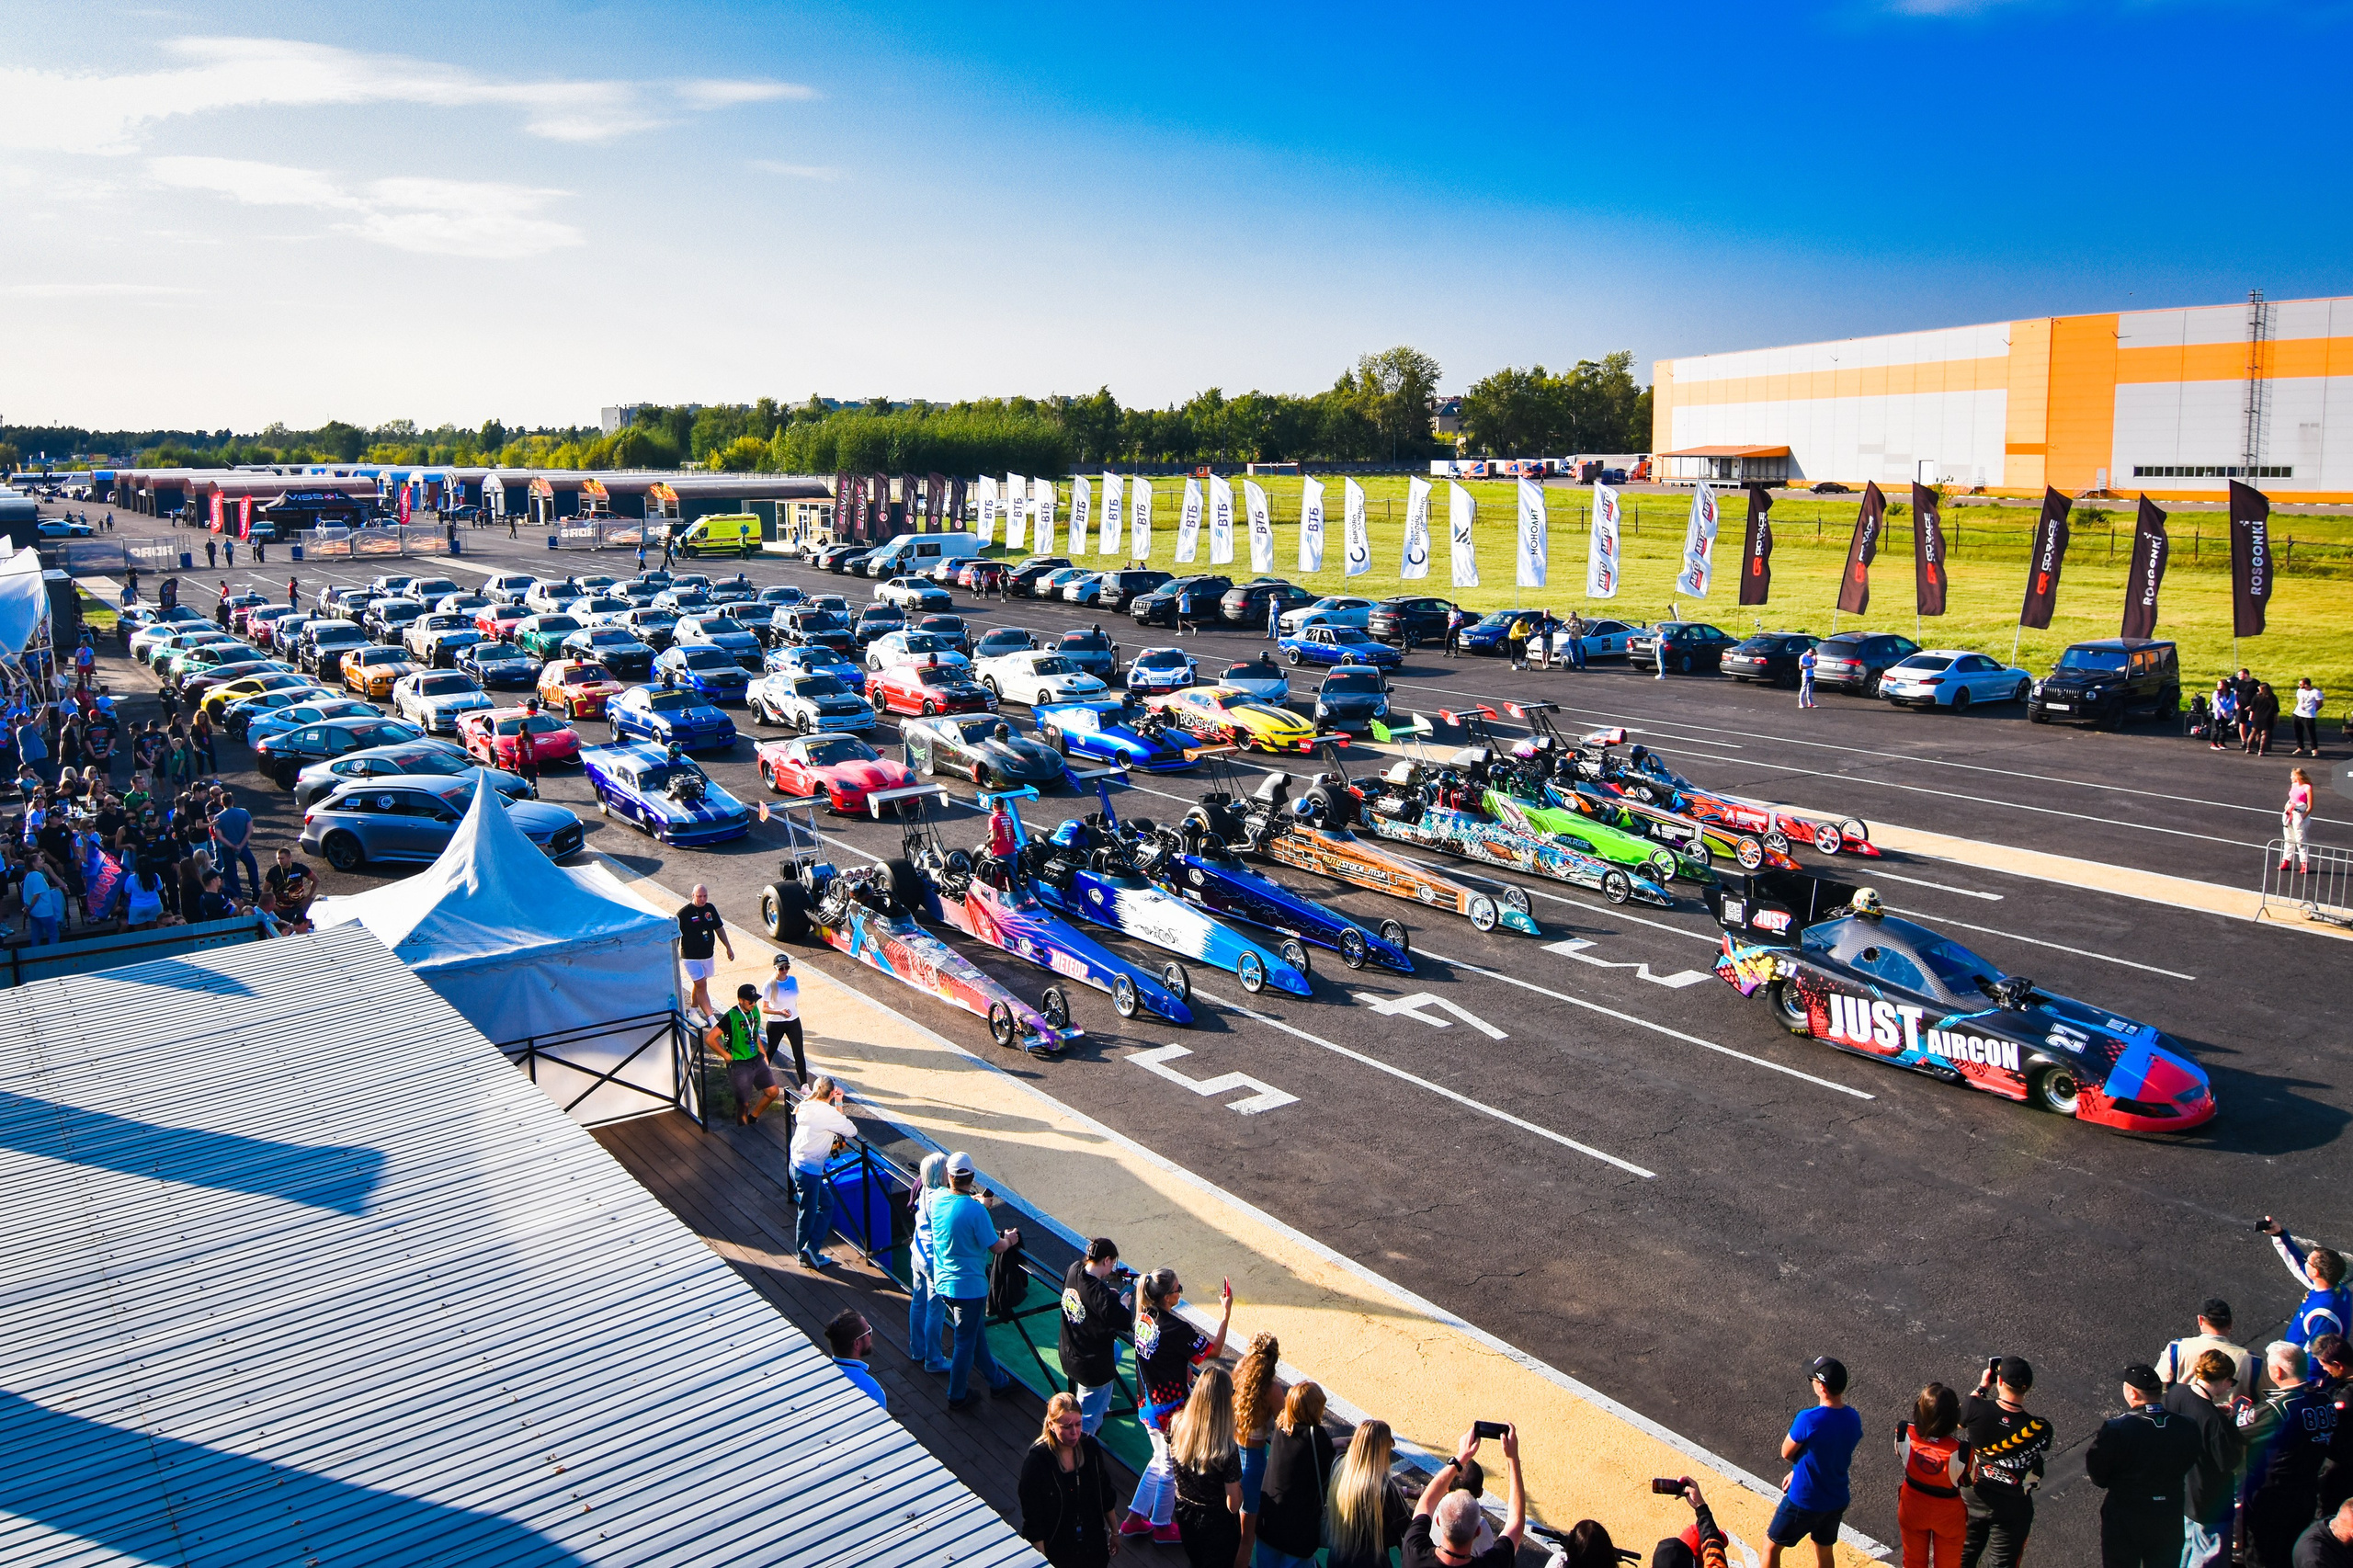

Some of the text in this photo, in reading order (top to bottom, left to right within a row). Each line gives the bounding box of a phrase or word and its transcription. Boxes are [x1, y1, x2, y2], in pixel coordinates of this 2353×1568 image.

[241, 497, 249, 536] VISSOL
[984, 500, 994, 519] ВТБ
[1013, 497, 1023, 517] ВТБ
[1040, 502, 1050, 522] ВТБ
[1075, 501, 1086, 522] ВТБ
[1108, 499, 1119, 520] ВТБ
[1137, 504, 1147, 525] ВТБ
[1187, 505, 1198, 528] ВТБ
[1218, 503, 1228, 527] ВТБ
[1256, 511, 1267, 534] ВТБ
[1308, 507, 1319, 532] ВТБ
[1530, 508, 1539, 556] МОНОЛИТ
[2250, 520, 2264, 596] ROSGONKI
[2143, 535, 2163, 607] ROSGONKI
[1757, 909, 1789, 931] JUST
[1051, 950, 1088, 978] МЕТЕОР
[1776, 960, 1798, 978] 27
[1353, 992, 1508, 1040] 4
[1828, 994, 2021, 1071] JUST AIRCON
[2045, 1022, 2089, 1054] 27
[2302, 1403, 2338, 1431] 888
